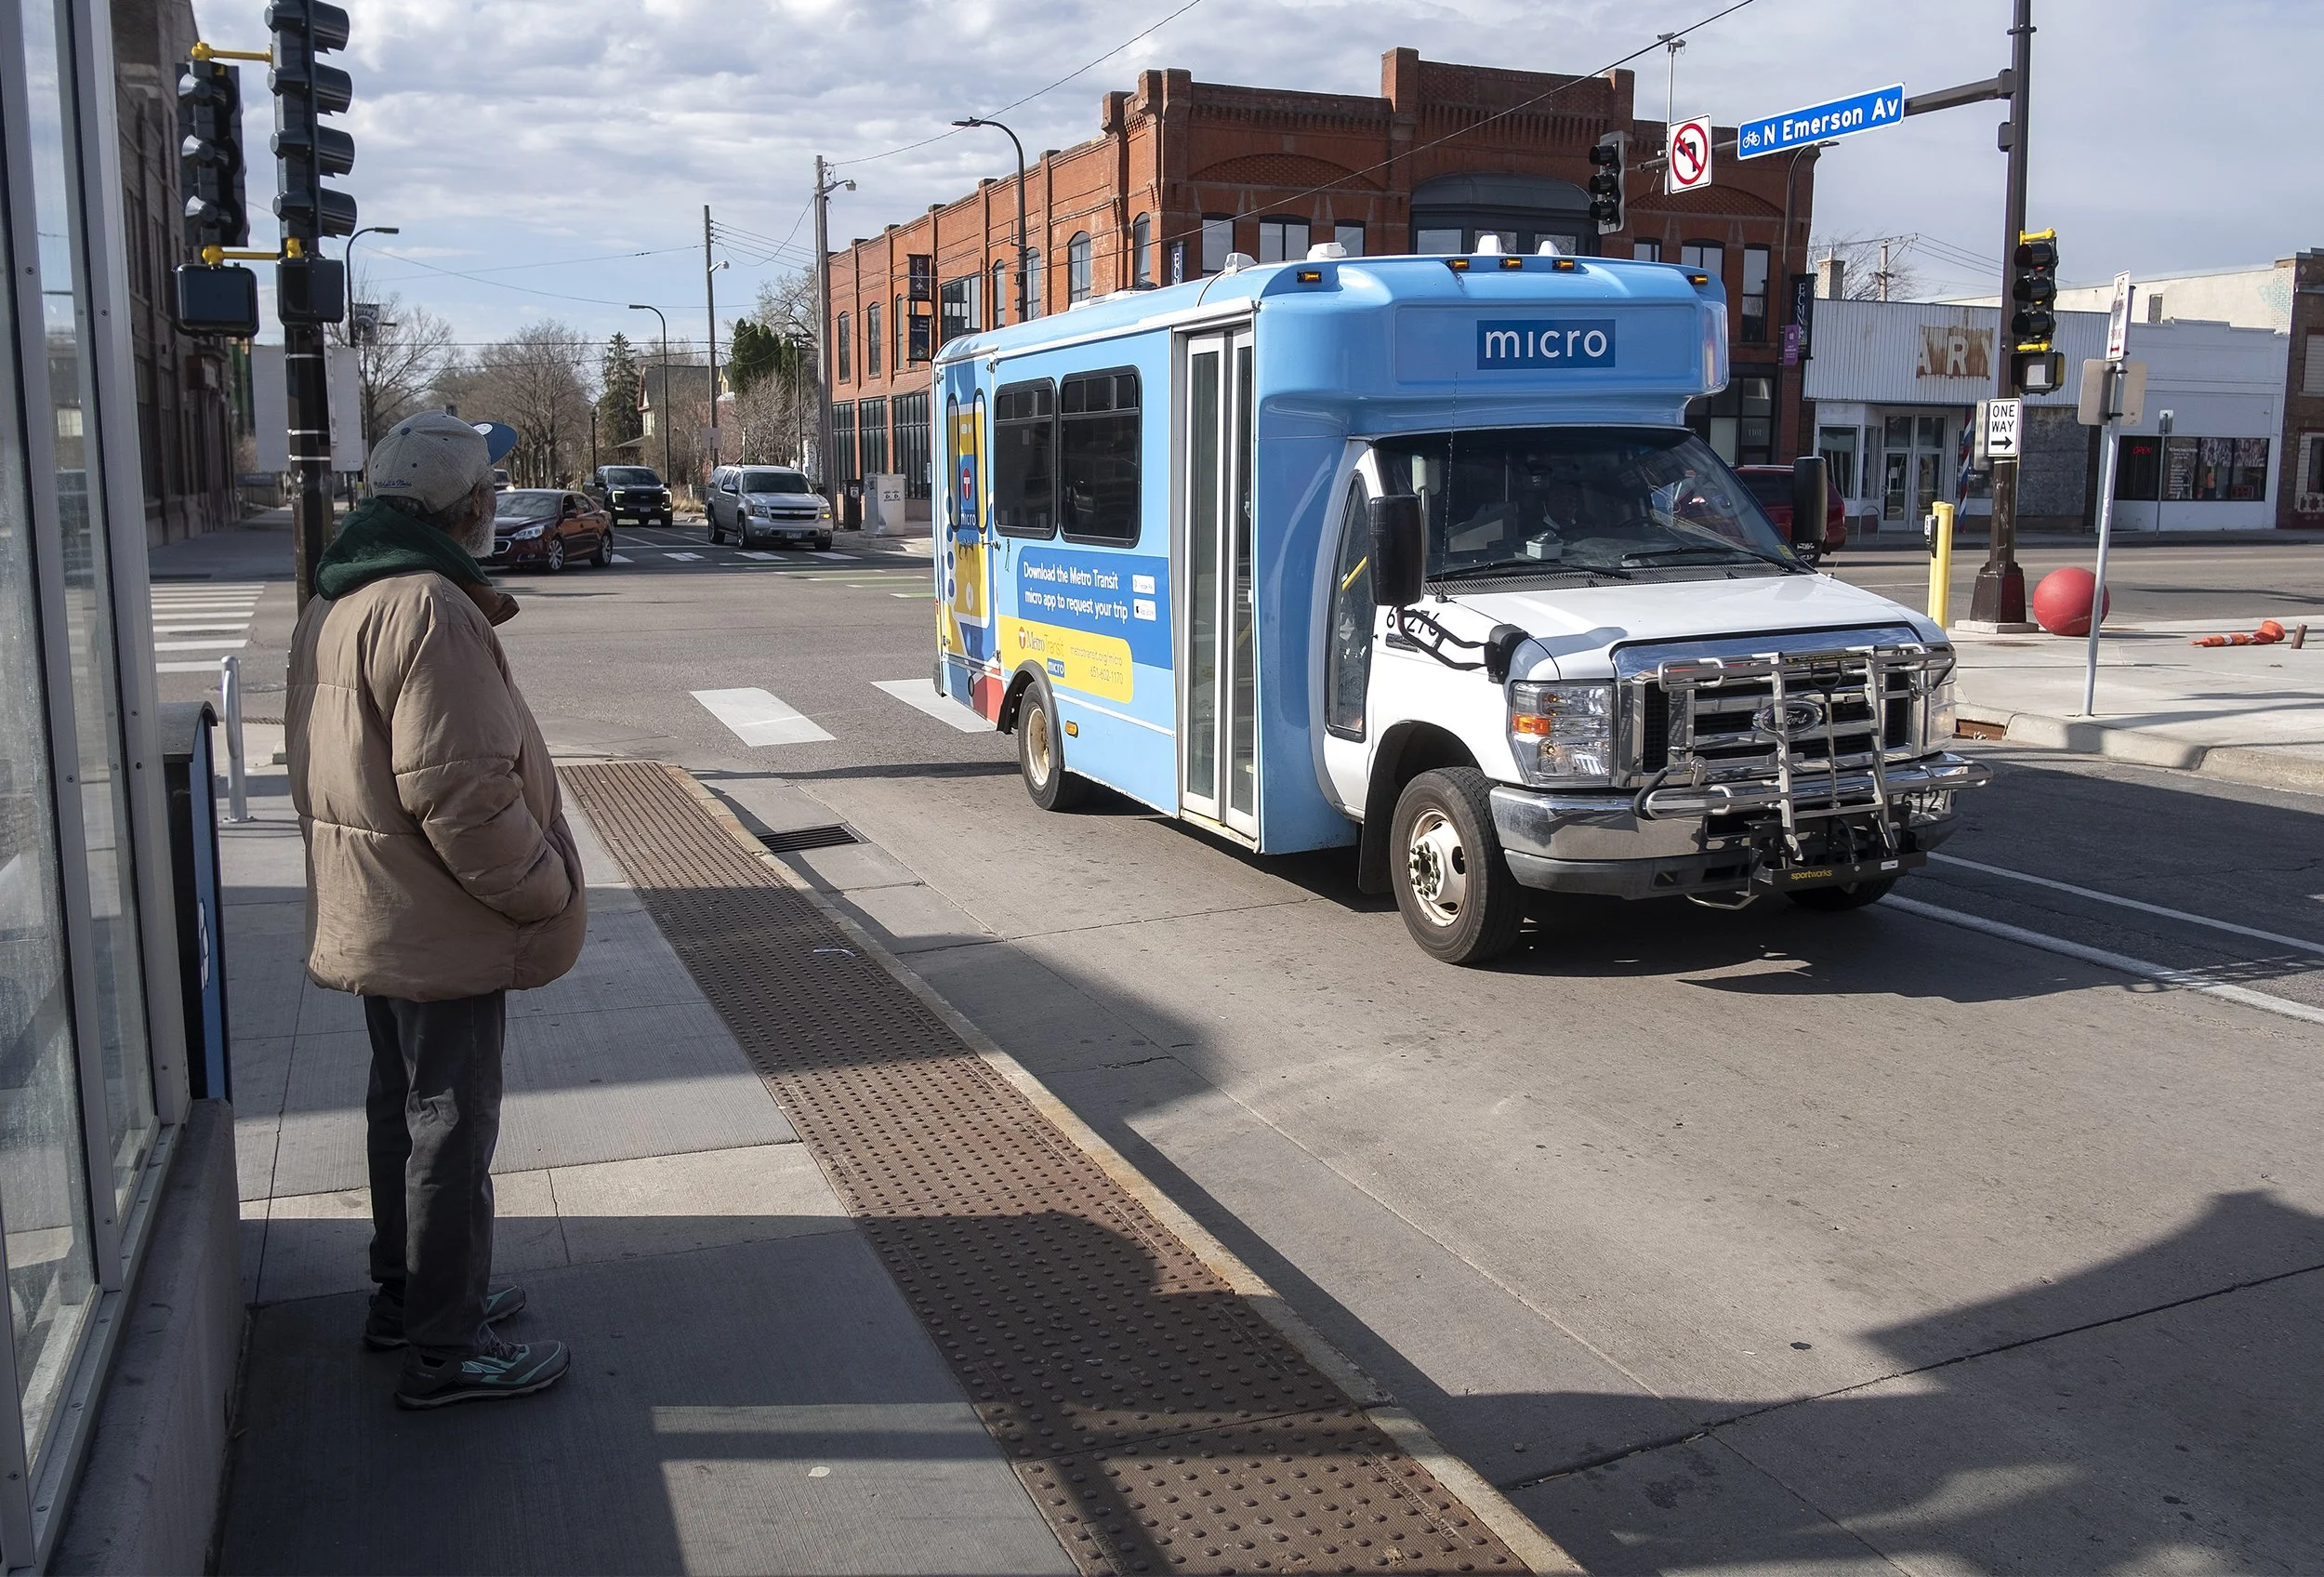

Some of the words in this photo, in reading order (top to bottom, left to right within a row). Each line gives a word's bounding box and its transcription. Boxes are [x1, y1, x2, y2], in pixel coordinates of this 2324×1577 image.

[1764, 124, 1776, 146] N
[1783, 107, 1863, 141] Emerson
[1871, 97, 1899, 121] Av
[1486, 330, 1607, 358] micro
[1992, 404, 2015, 418] ONE
[1991, 419, 2015, 433] WAY
[1023, 561, 1056, 582] Download
[1056, 564, 1069, 584] the
[1070, 566, 1092, 587] Metro
[1092, 568, 1119, 590] Transit
[1024, 587, 1042, 605] micro
[1043, 593, 1056, 612] app
[1056, 592, 1065, 609] to
[1066, 597, 1094, 616] request
[1094, 602, 1113, 620] your
[1113, 600, 1129, 624] trip
[1048, 660, 1064, 675] micro
[1790, 869, 1832, 880] sportworks
